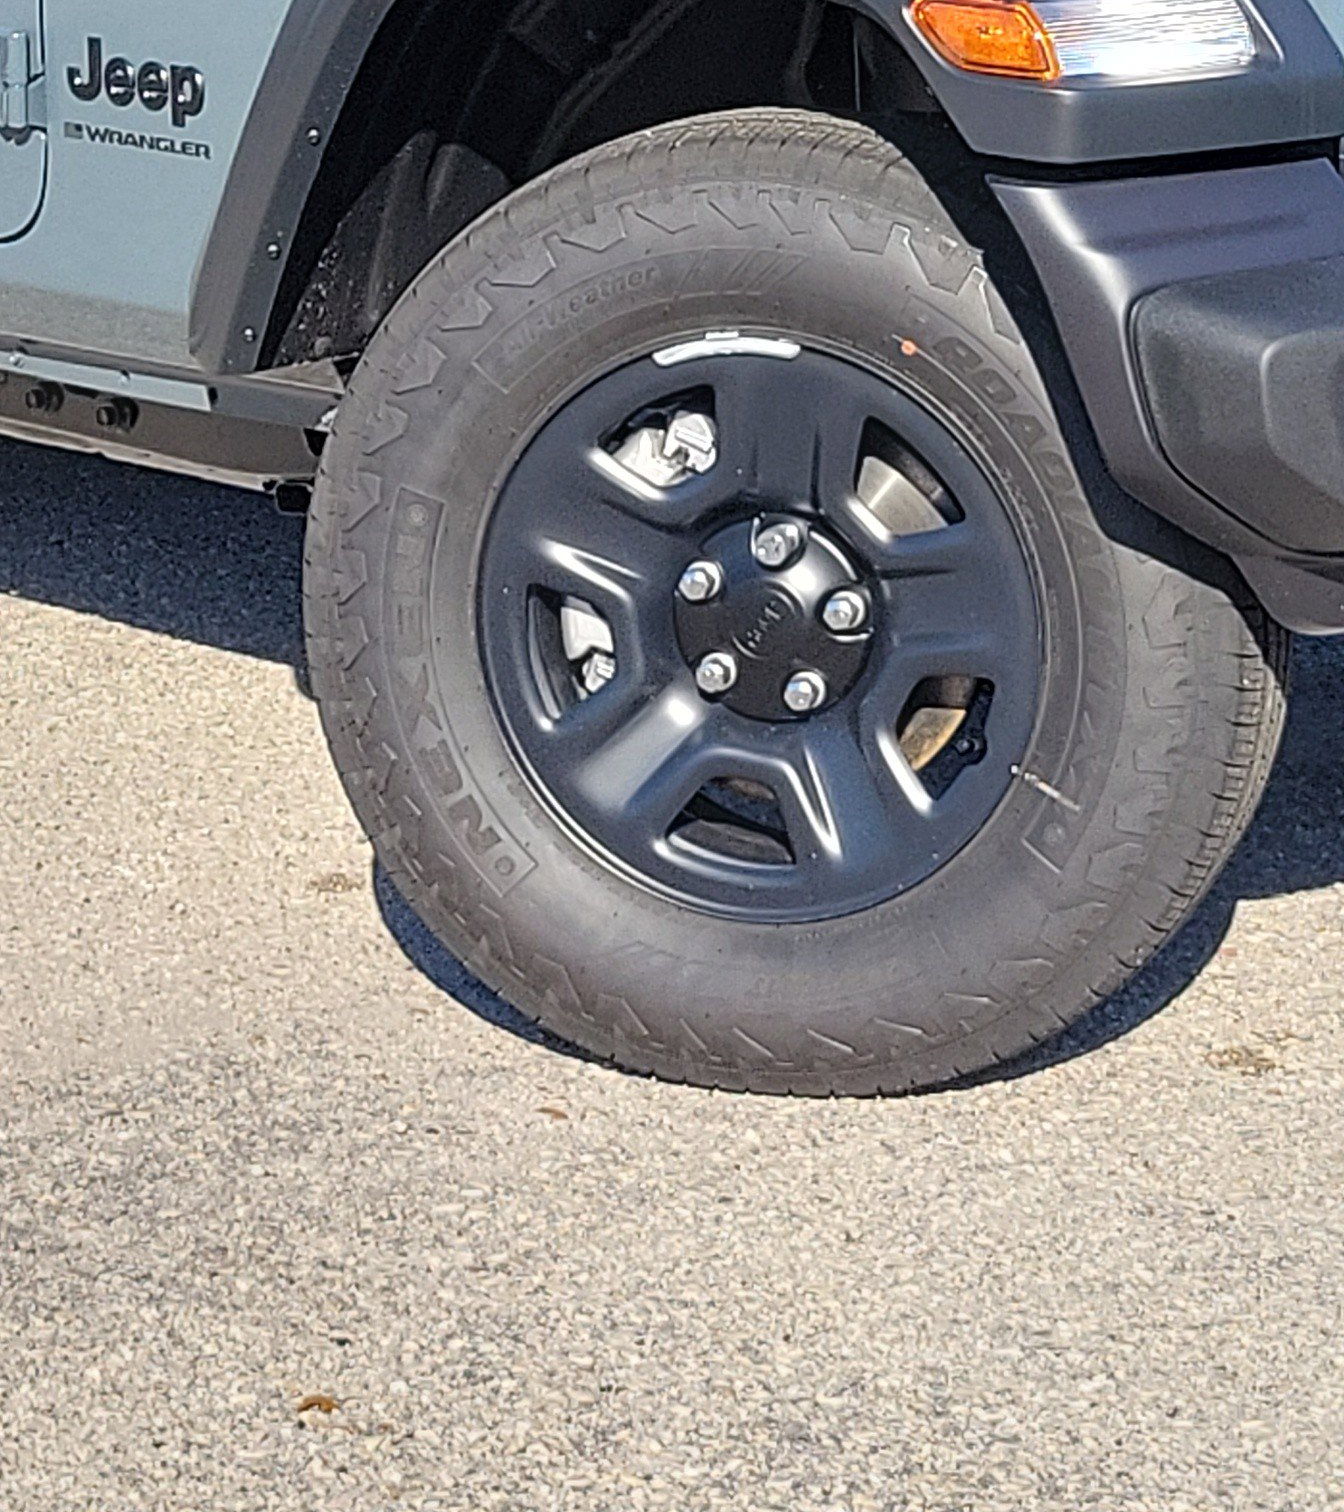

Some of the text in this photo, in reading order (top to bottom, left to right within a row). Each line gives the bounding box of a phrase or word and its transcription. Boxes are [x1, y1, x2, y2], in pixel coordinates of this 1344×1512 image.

[66, 36, 206, 128] Jeep
[86, 124, 211, 160] WRANGLER
[390, 534, 502, 855] NEXEN
